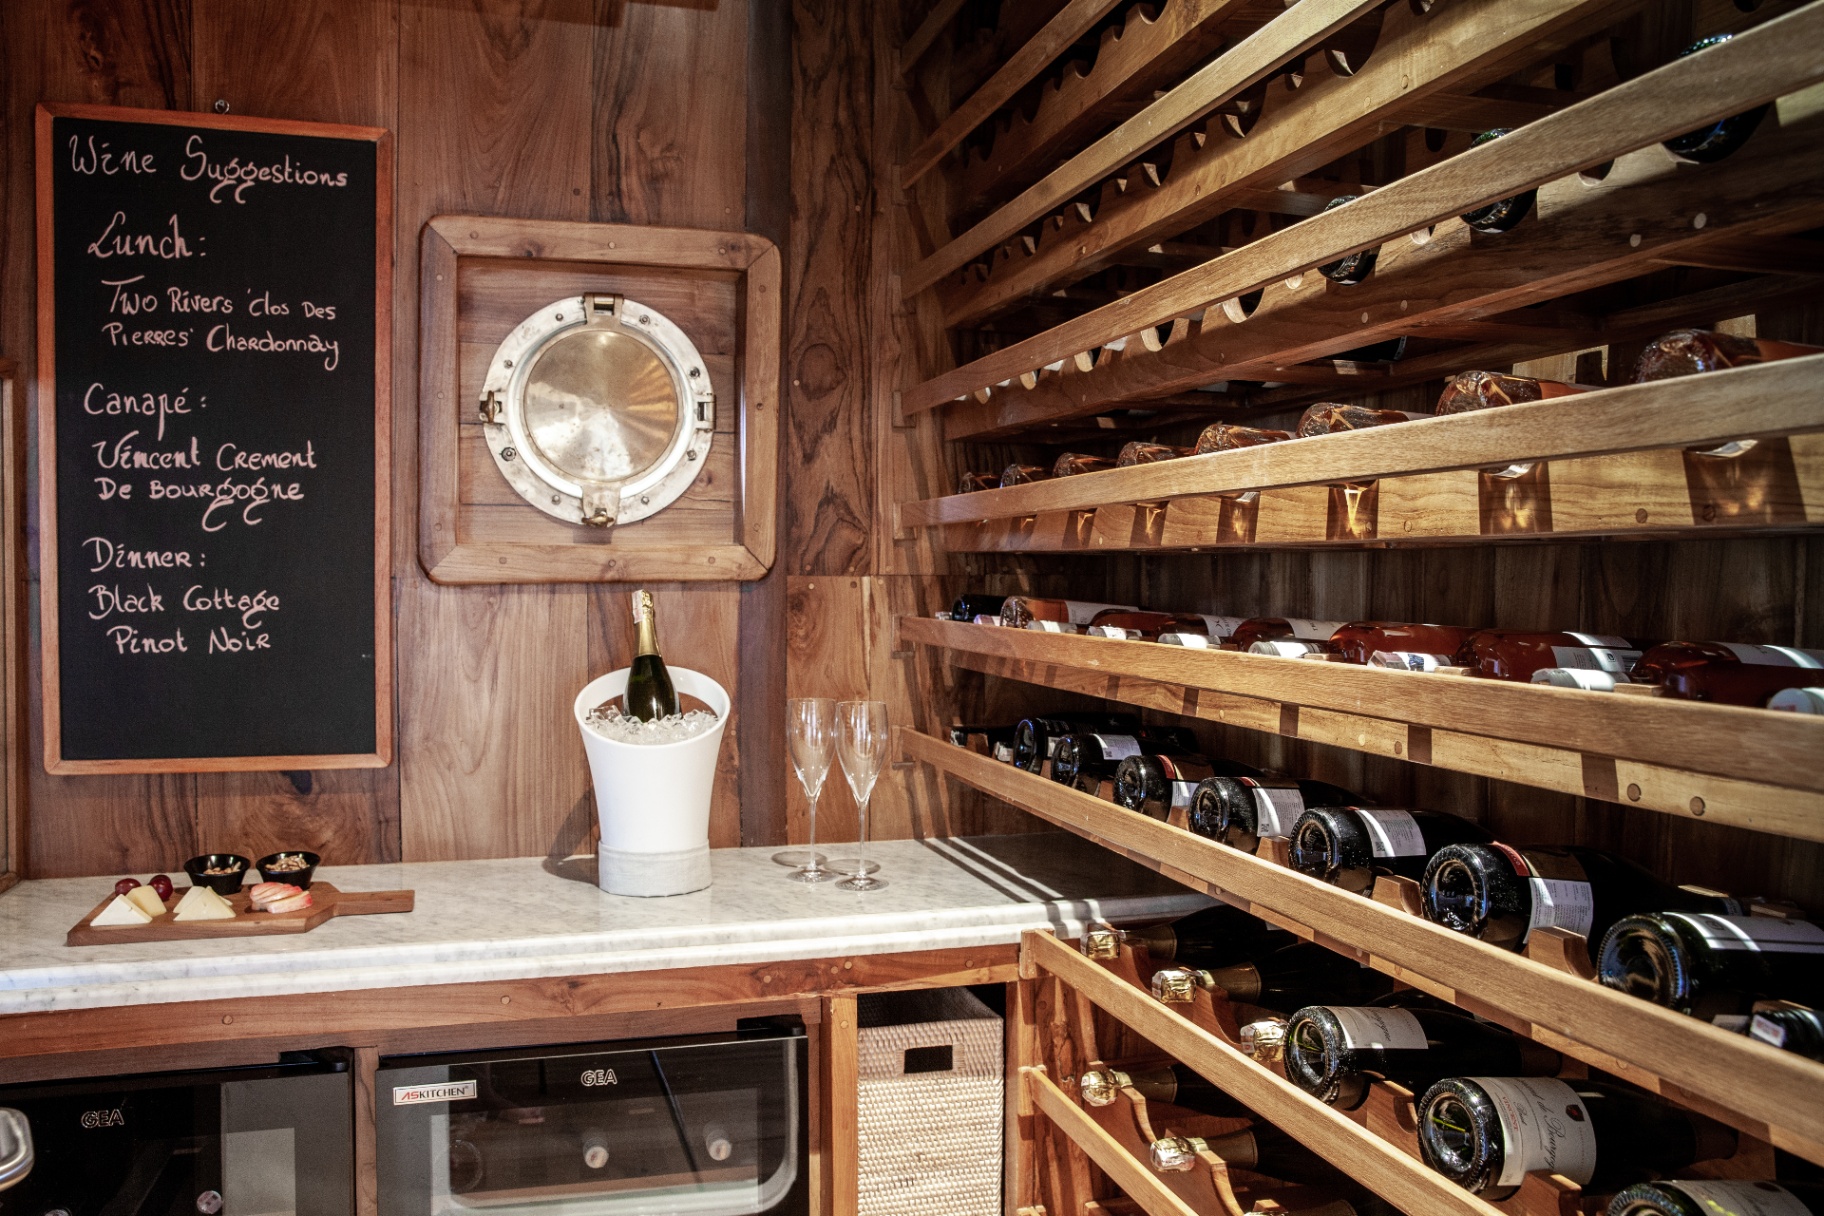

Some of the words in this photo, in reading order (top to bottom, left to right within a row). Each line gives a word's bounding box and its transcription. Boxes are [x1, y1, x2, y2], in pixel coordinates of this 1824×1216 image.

[70, 135, 156, 174] Wine
[180, 135, 348, 204] Suggestions
[101, 275, 157, 315] Two
[167, 287, 233, 314] Rivers
[302, 301, 336, 320] Des
[206, 322, 339, 371] Chardonnay
[92, 430, 201, 469] Vincent
[216, 440, 318, 471] Crement
[94, 477, 132, 501] De
[149, 476, 304, 532] Bourgogne
[88, 583, 165, 620] Black
[182, 584, 280, 629] Cottage
[106, 625, 188, 655] Pinot
[209, 626, 271, 655] Noir
[580, 1068, 618, 1087] GEA
[80, 1108, 125, 1129] GEA
